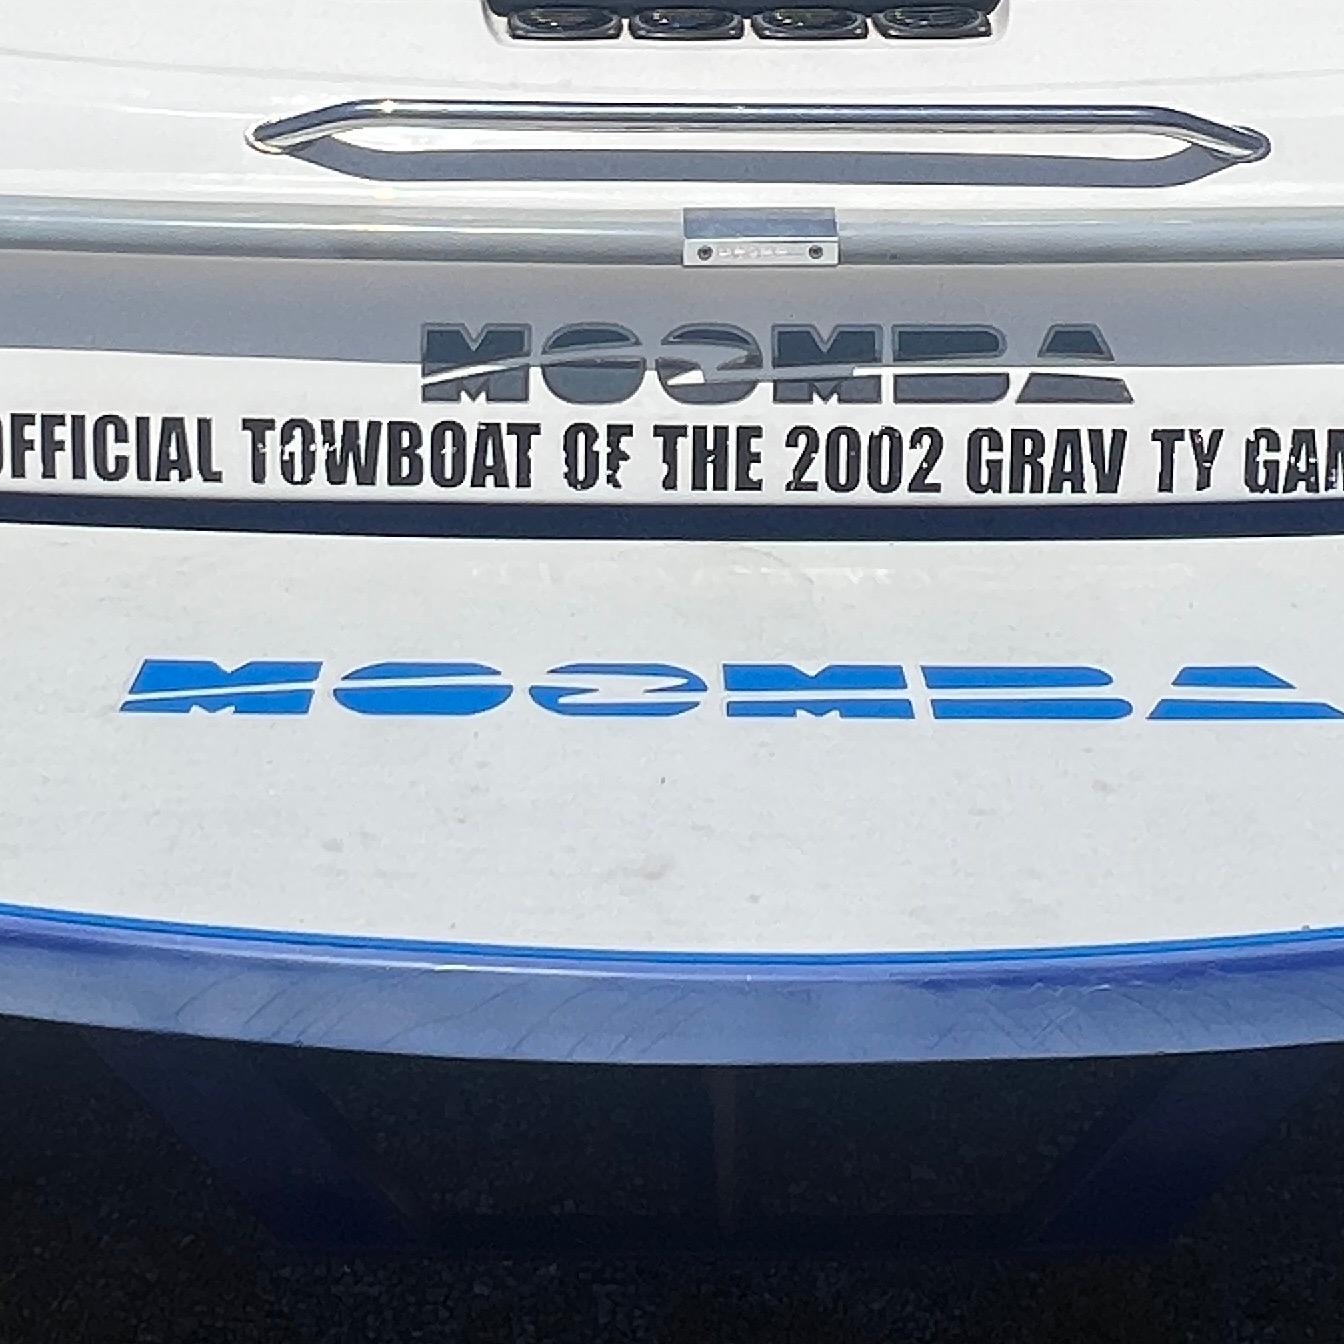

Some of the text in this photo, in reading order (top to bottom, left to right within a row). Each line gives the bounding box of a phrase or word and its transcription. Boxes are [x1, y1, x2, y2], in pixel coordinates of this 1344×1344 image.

[421, 322, 1134, 405] MOOMBA
[242, 418, 542, 489] TOWBOAT
[562, 422, 634, 492] OF
[652, 424, 764, 492] THE
[784, 425, 944, 494] 2002
